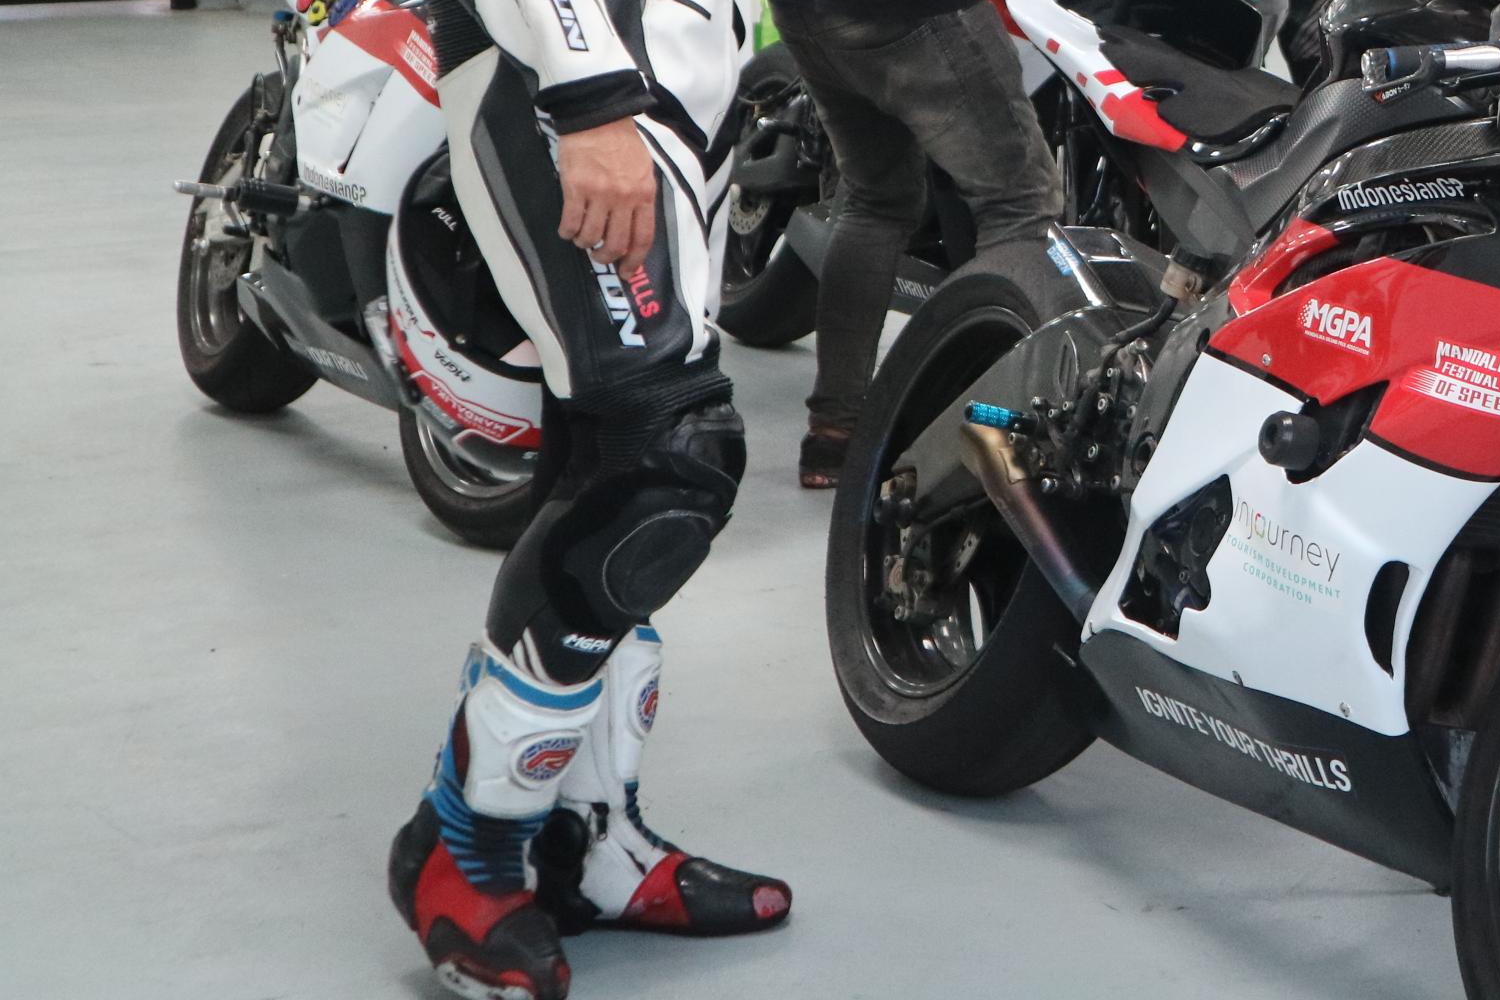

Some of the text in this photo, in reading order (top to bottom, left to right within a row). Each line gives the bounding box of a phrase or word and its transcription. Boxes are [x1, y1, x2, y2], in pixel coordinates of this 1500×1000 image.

[1338, 177, 1465, 211] IndonesianGP
[431, 207, 458, 232] PULL
[1300, 298, 1372, 348] MGPA
[1434, 380, 1457, 397] OF
[1441, 361, 1500, 390] FESTIVAL
[1233, 495, 1340, 582] injourney
[1226, 534, 1341, 599] TOURISM DEVELOPMENT
[1242, 562, 1312, 604] CORPORATION
[562, 633, 614, 652] MGPA
[1135, 686, 1352, 793] IGNITE YOUR THRILLS
